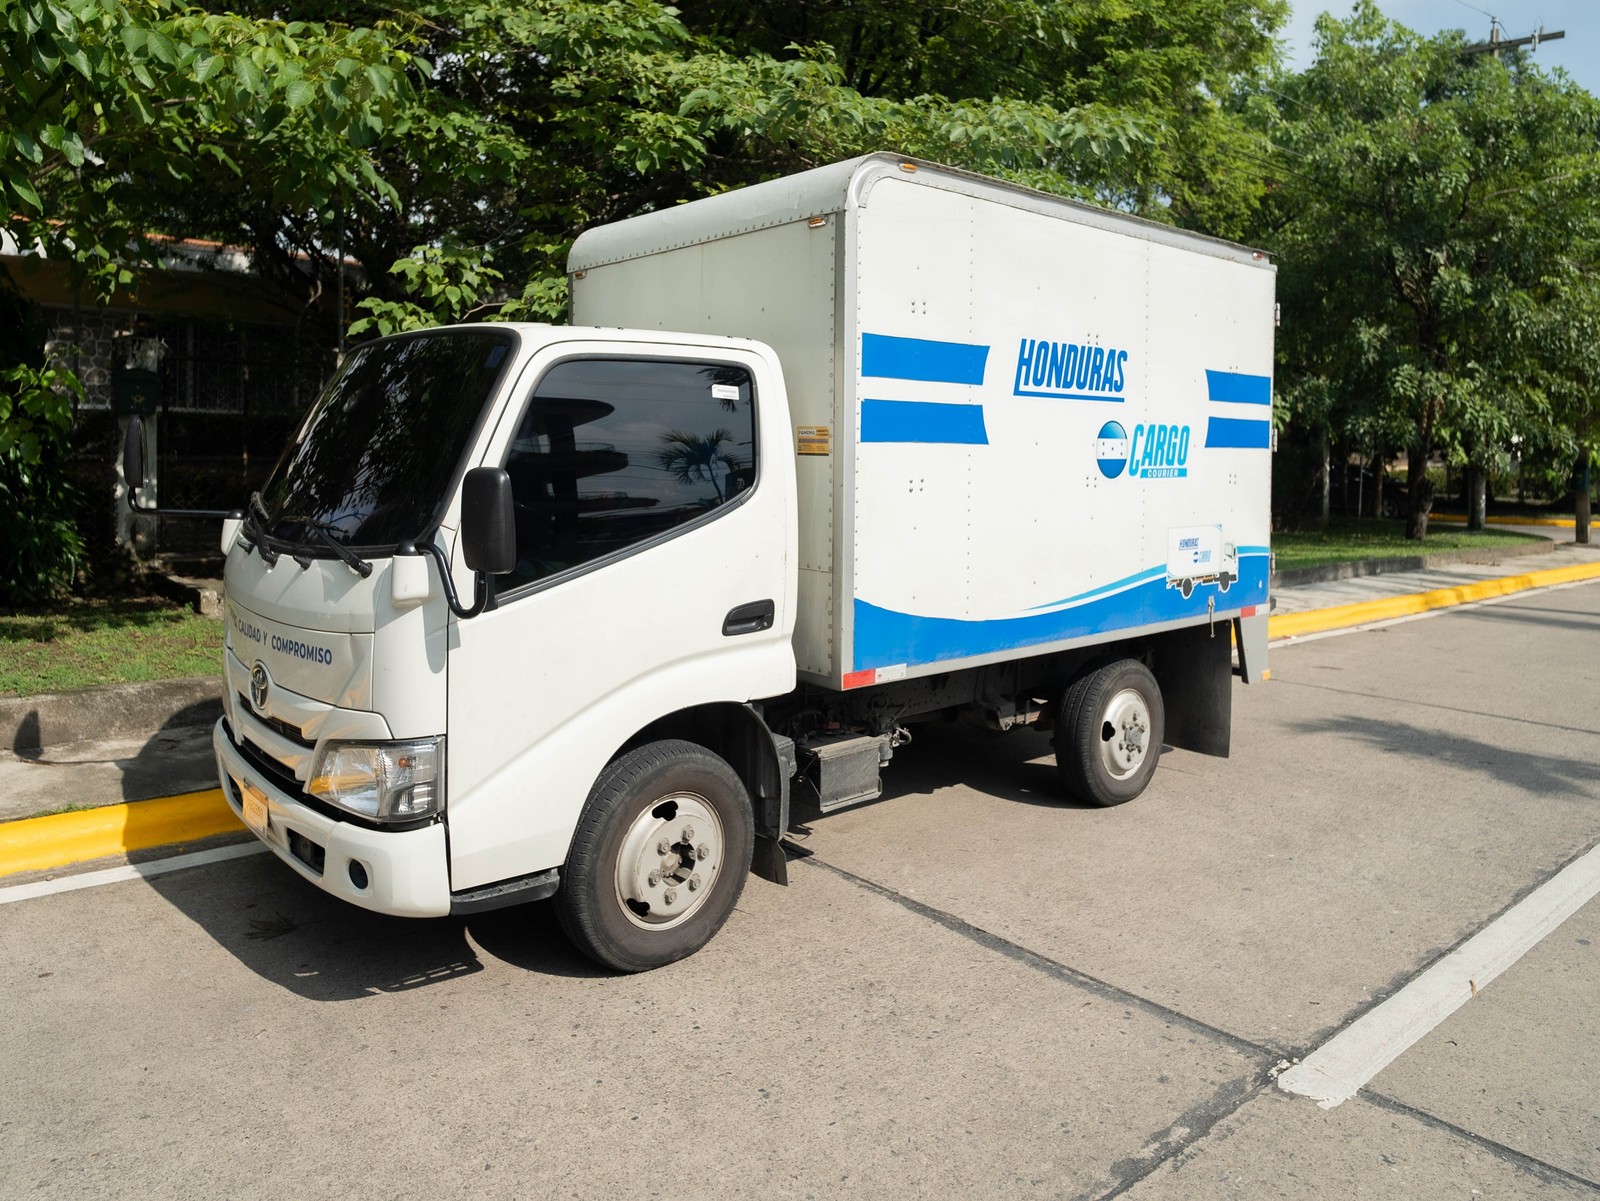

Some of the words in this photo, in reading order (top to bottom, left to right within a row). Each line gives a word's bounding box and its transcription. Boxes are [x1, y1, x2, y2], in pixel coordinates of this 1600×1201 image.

[1014, 338, 1128, 395] HONDURAS
[1128, 423, 1190, 476] CARGO
[1147, 468, 1179, 478] COURIER
[238, 619, 261, 642] CALIDAD
[263, 631, 268, 646] Y
[271, 635, 332, 665] COMPROMISO
